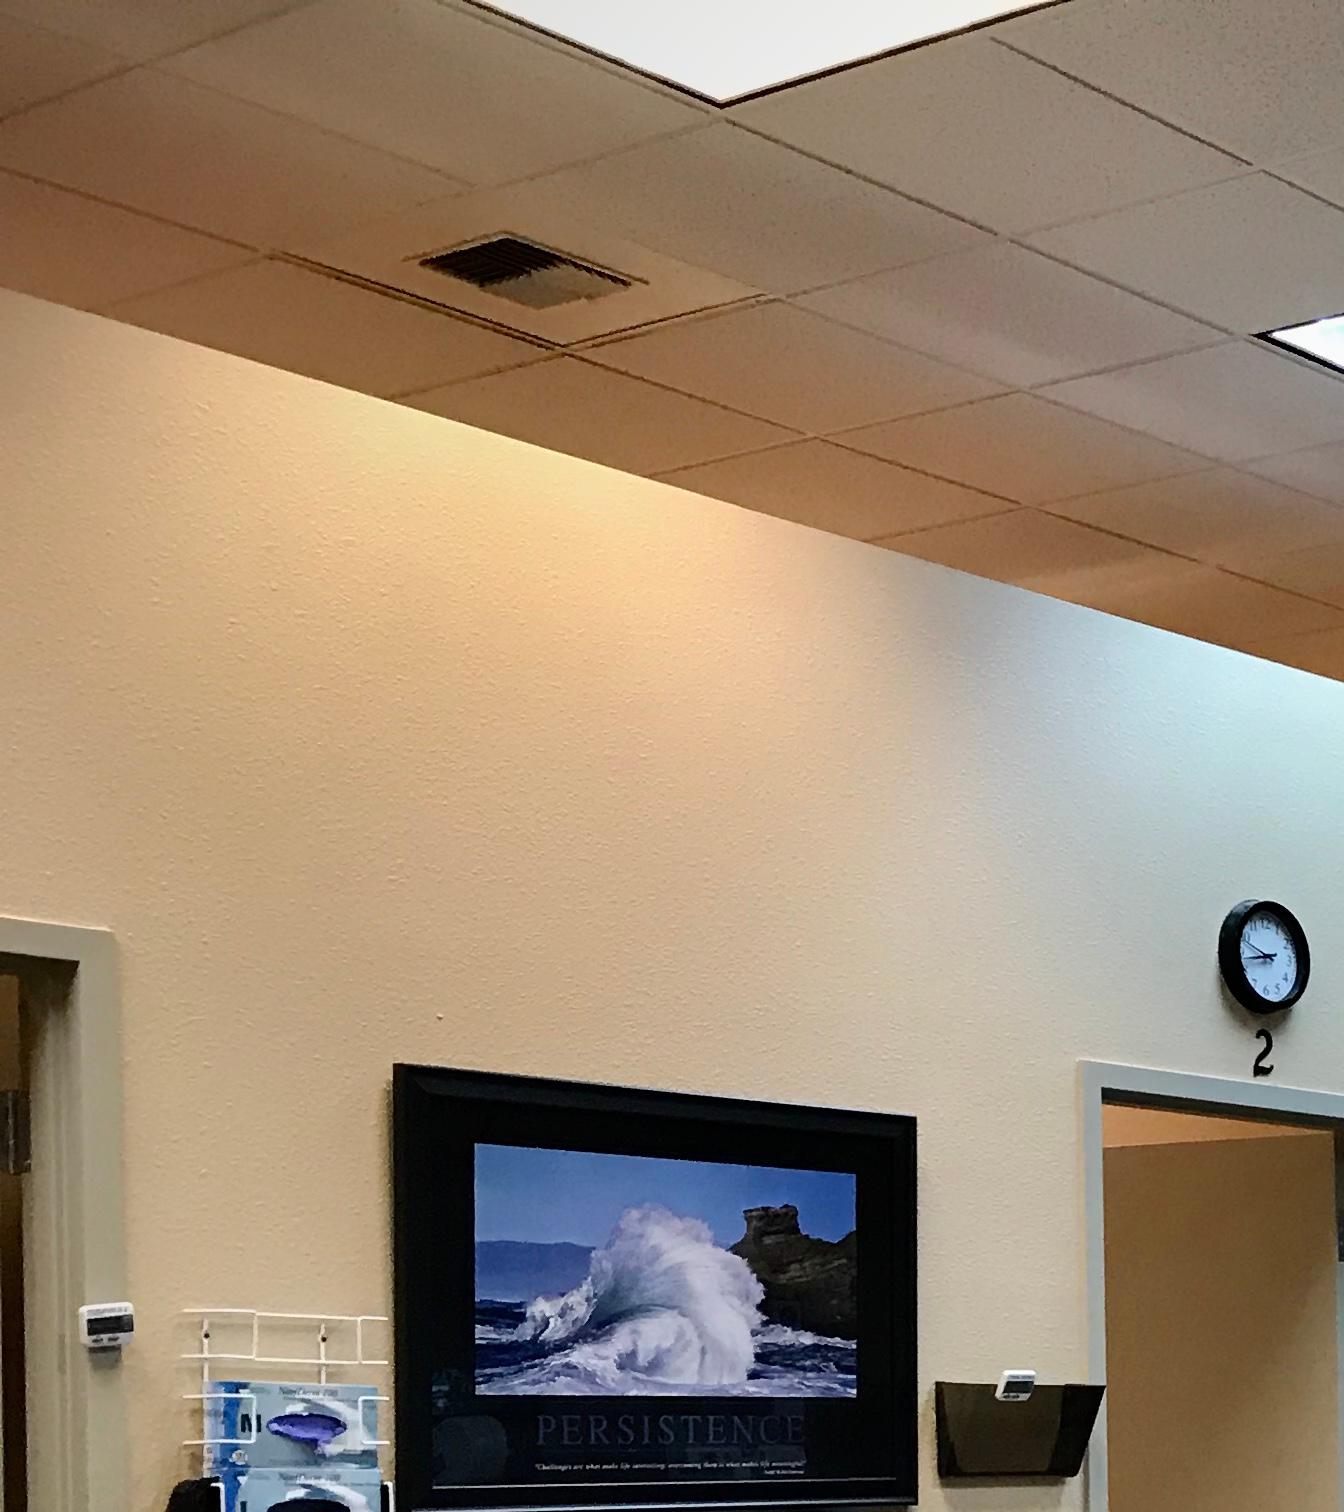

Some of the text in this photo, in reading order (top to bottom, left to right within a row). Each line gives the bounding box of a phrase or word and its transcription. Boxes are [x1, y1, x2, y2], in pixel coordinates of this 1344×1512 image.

[1253, 1028, 1274, 1077] 2
[240, 1413, 261, 1433] M
[536, 1414, 805, 1446] PERSISTENCE
